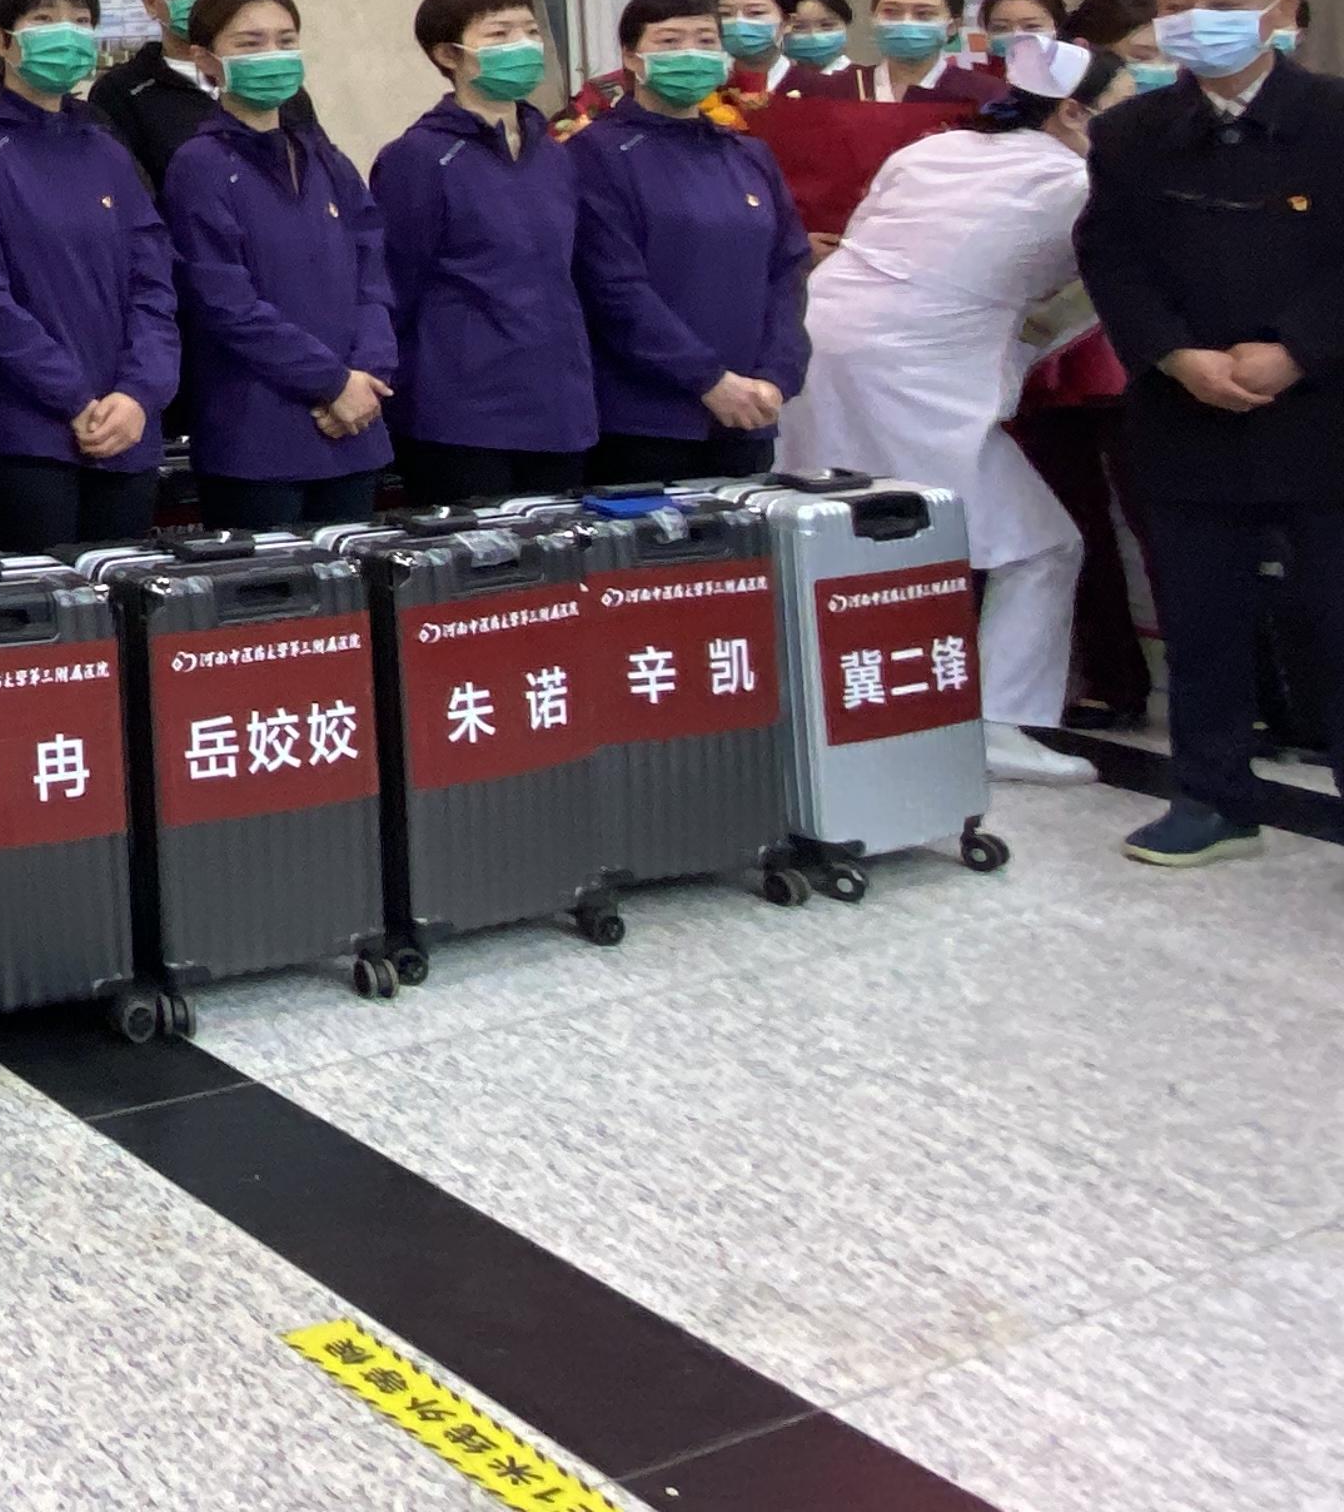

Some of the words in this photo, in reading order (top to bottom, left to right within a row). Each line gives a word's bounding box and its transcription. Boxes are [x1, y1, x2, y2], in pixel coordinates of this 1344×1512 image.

[446, 665, 568, 744] 朱诺
[626, 638, 756, 705] 辛凯
[839, 634, 969, 710] 冀二锋
[184, 698, 360, 780] 岳姣姣
[322, 1335, 614, 1512] 1米线外等候
